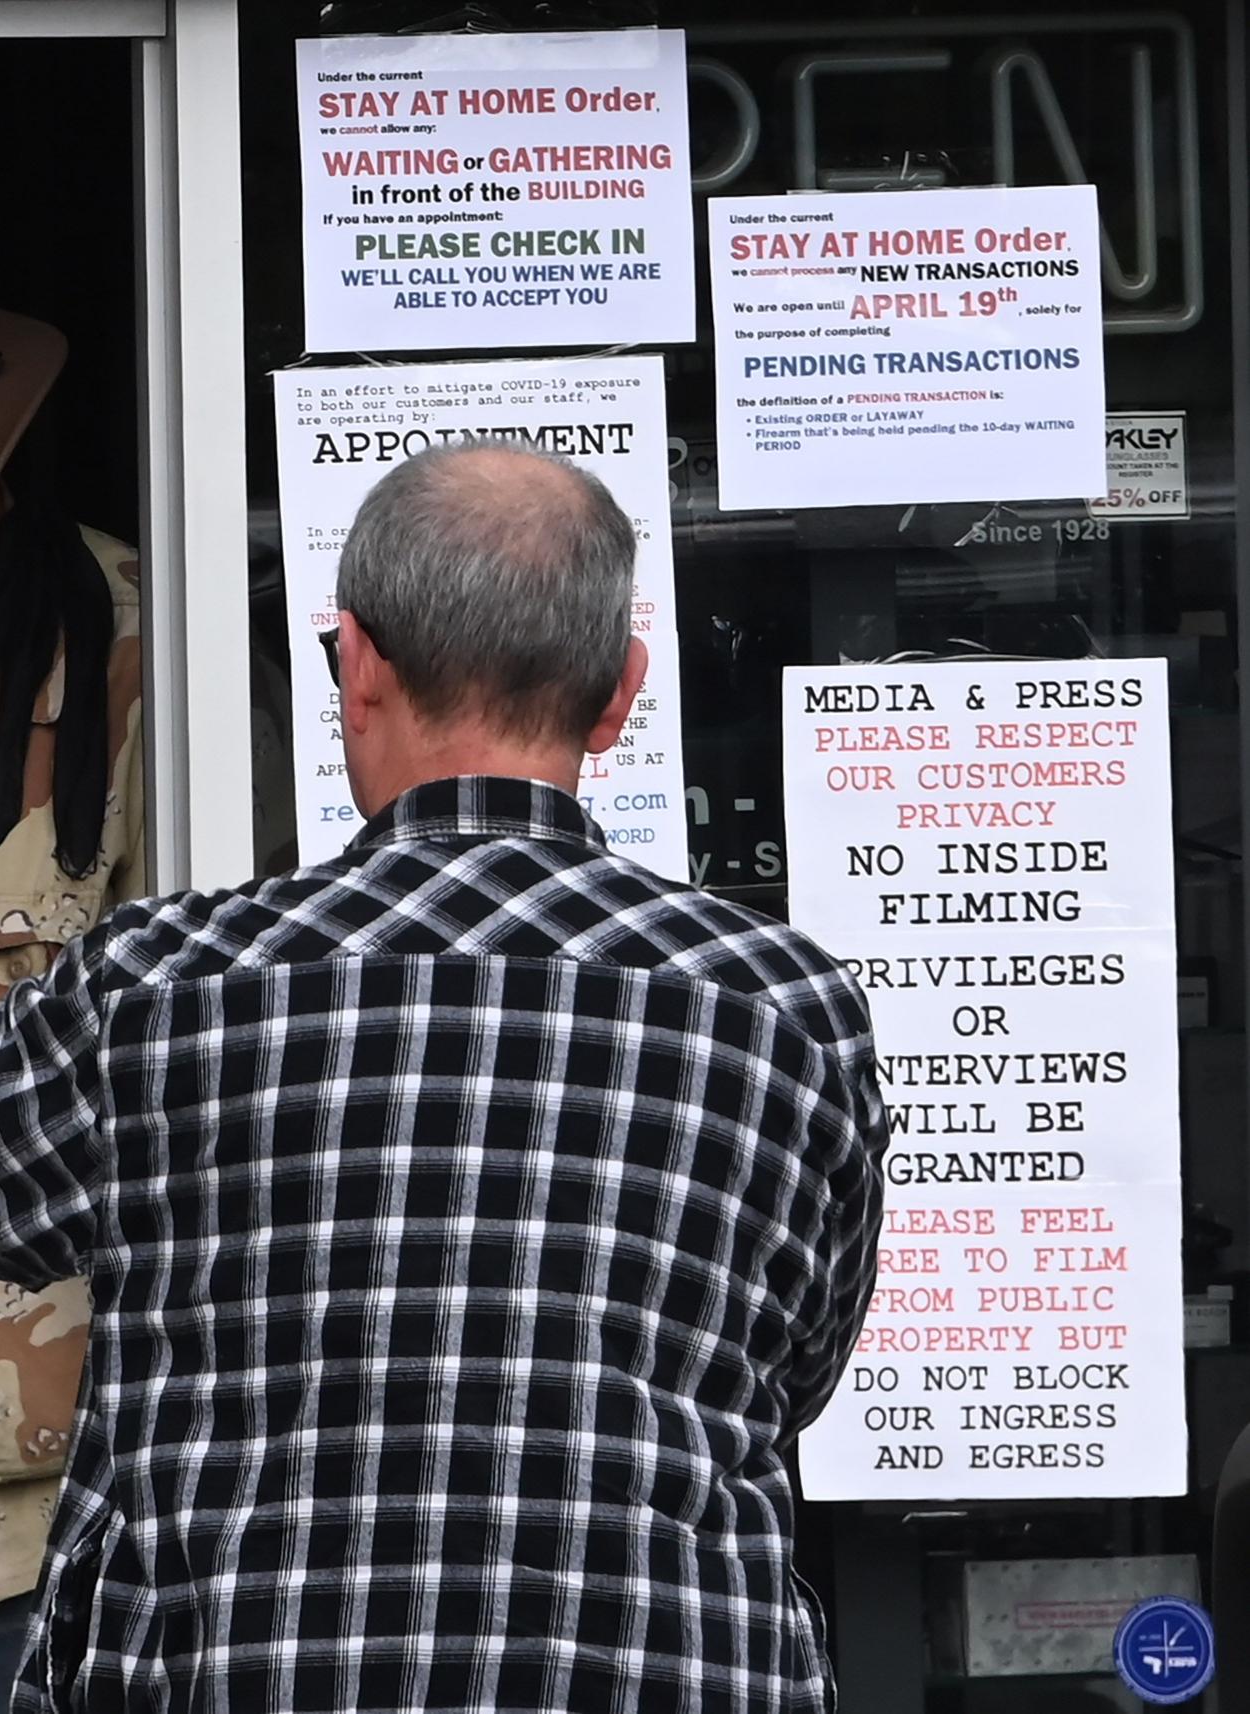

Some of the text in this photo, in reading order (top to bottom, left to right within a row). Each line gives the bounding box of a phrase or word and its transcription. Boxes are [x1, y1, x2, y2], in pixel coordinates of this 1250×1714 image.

[318, 71, 423, 82] Under the current
[319, 92, 399, 118] STAY
[410, 90, 448, 116] AT
[459, 88, 555, 114] HOME
[339, 124, 378, 134] cannot
[381, 124, 410, 133] allow
[413, 125, 436, 134] any:
[322, 144, 671, 176] WAITING or GATHERING
[353, 179, 644, 204] in front of the BUILDING
[324, 214, 333, 224] If
[337, 217, 359, 226] you
[363, 214, 394, 223] have
[398, 215, 413, 223] an
[730, 213, 833, 224] Under the current
[356, 228, 644, 260] PLEASE CHECK IN
[731, 233, 810, 260] STAY
[821, 232, 858, 258] AT
[869, 229, 964, 256] HOME
[409, 268, 460, 285] CALL
[465, 267, 506, 283] YOU
[512, 265, 574, 282] WHEN
[580, 264, 613, 280] WE
[619, 263, 660, 280] ARE
[750, 266, 788, 276] cannot
[791, 267, 834, 276] process
[837, 267, 857, 275] any
[861, 265, 909, 282] NEW
[915, 260, 1078, 280] TRANSACTIONS
[394, 288, 607, 309] ABLE TO ACCEPT YOU
[734, 303, 753, 312] We
[758, 304, 777, 312] are
[782, 303, 813, 313] open
[817, 301, 845, 310] until
[850, 293, 947, 320] APRIL
[1026, 305, 1061, 315] solely
[1065, 304, 1081, 313] for
[735, 326, 890, 340] the purpose of completing
[745, 348, 1079, 378] PENDING TRANSACTIONS
[297, 378, 640, 397] In an effort to mitigate COVID-19 exposure
[737, 398, 756, 407] the
[760, 396, 817, 406] definition
[821, 395, 833, 405] of
[847, 393, 901, 403] PENDING
[905, 391, 986, 401] TRANSACTION
[990, 391, 1003, 399] is:
[330, 413, 404, 427] operating
[413, 411, 435, 424] by:
[755, 415, 802, 425] Existing
[806, 413, 847, 422] ORDER
[867, 411, 923, 422] LAYAWAY
[1106, 428, 1178, 449] AKLEY
[1149, 490, 1181, 503] OFF
[972, 519, 1110, 543] Since 1928
[805, 679, 1142, 713] MEDIA & PRESS
[815, 721, 1136, 752] PLEASE RESPECT
[827, 760, 1125, 791] OUR CUSTOMERS
[897, 801, 1056, 828] PRIVACY
[847, 841, 1107, 876] NO INSIDE
[879, 890, 1081, 924] FILMING
[953, 1006, 1009, 1036] OR
[875, 1052, 1127, 1086] NTERVIEWS
[885, 1102, 1083, 1134] WILL BE
[888, 1152, 1084, 1185] GRANTED
[886, 1208, 1113, 1234] LEASE FEEL
[878, 1247, 1127, 1273] REE TO FILM
[868, 1286, 1113, 1312] FROM PUBLIC
[857, 1325, 1126, 1352] PROPERTY BUT
[854, 1364, 1129, 1392] DO NOT BLOCK
[865, 1404, 1116, 1431] OUR INGRESS
[874, 1443, 1104, 1469] AND EGRESS
